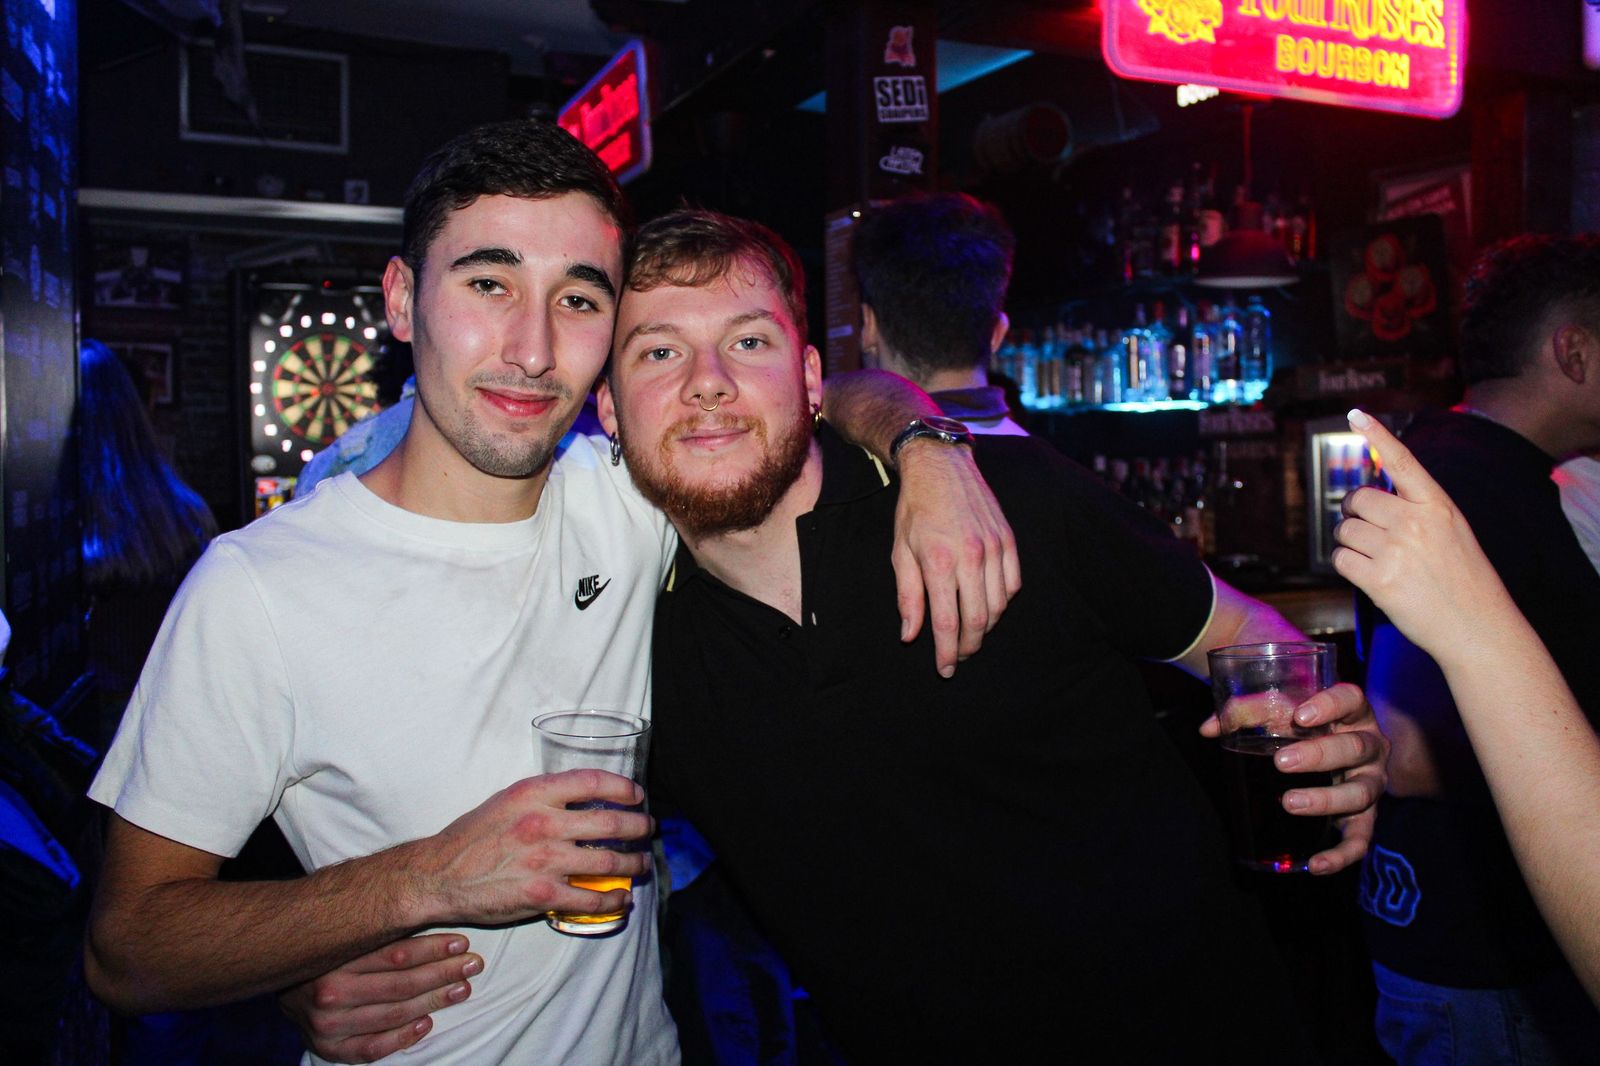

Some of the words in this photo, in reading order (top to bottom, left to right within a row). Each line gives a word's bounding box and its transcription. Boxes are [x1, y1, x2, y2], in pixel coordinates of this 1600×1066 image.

[1238, 0, 1327, 28] our
[1276, 34, 1410, 89] BOURBON
[578, 574, 600, 597] NIKE
